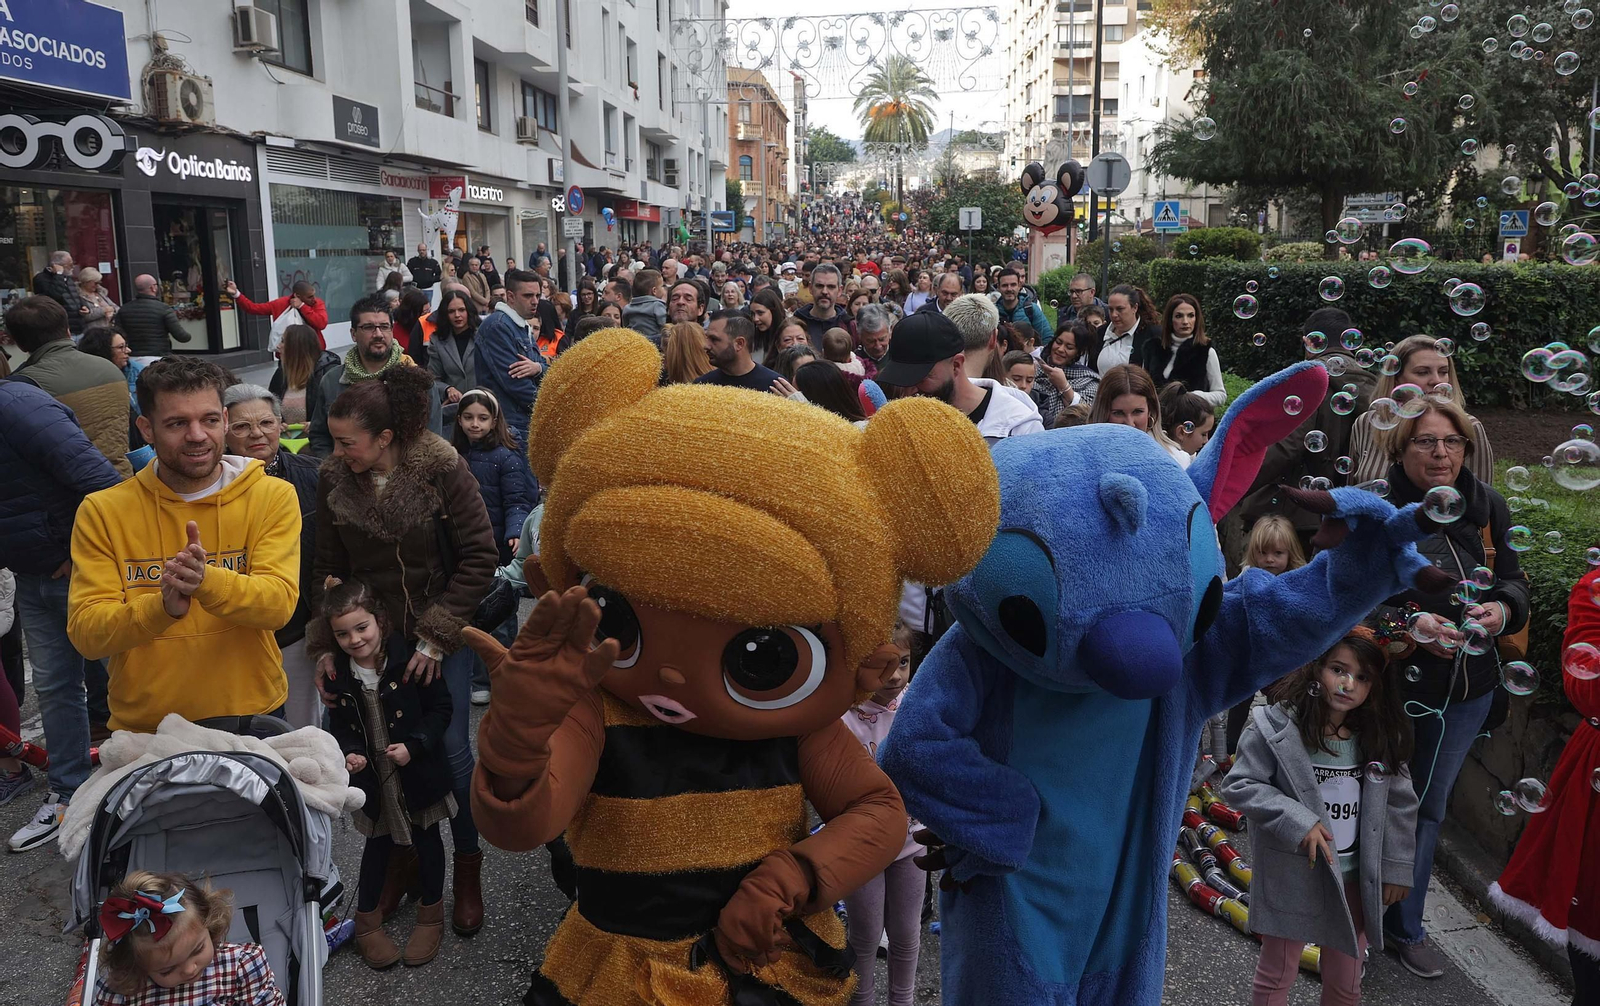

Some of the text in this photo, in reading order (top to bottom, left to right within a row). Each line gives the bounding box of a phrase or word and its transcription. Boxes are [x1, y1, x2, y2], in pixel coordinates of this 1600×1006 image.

[0, 26, 107, 69] ASOCIADOS
[1, 52, 33, 70] DOS
[347, 122, 369, 136] proseo
[1314, 768, 1351, 778] ARRASTRE
